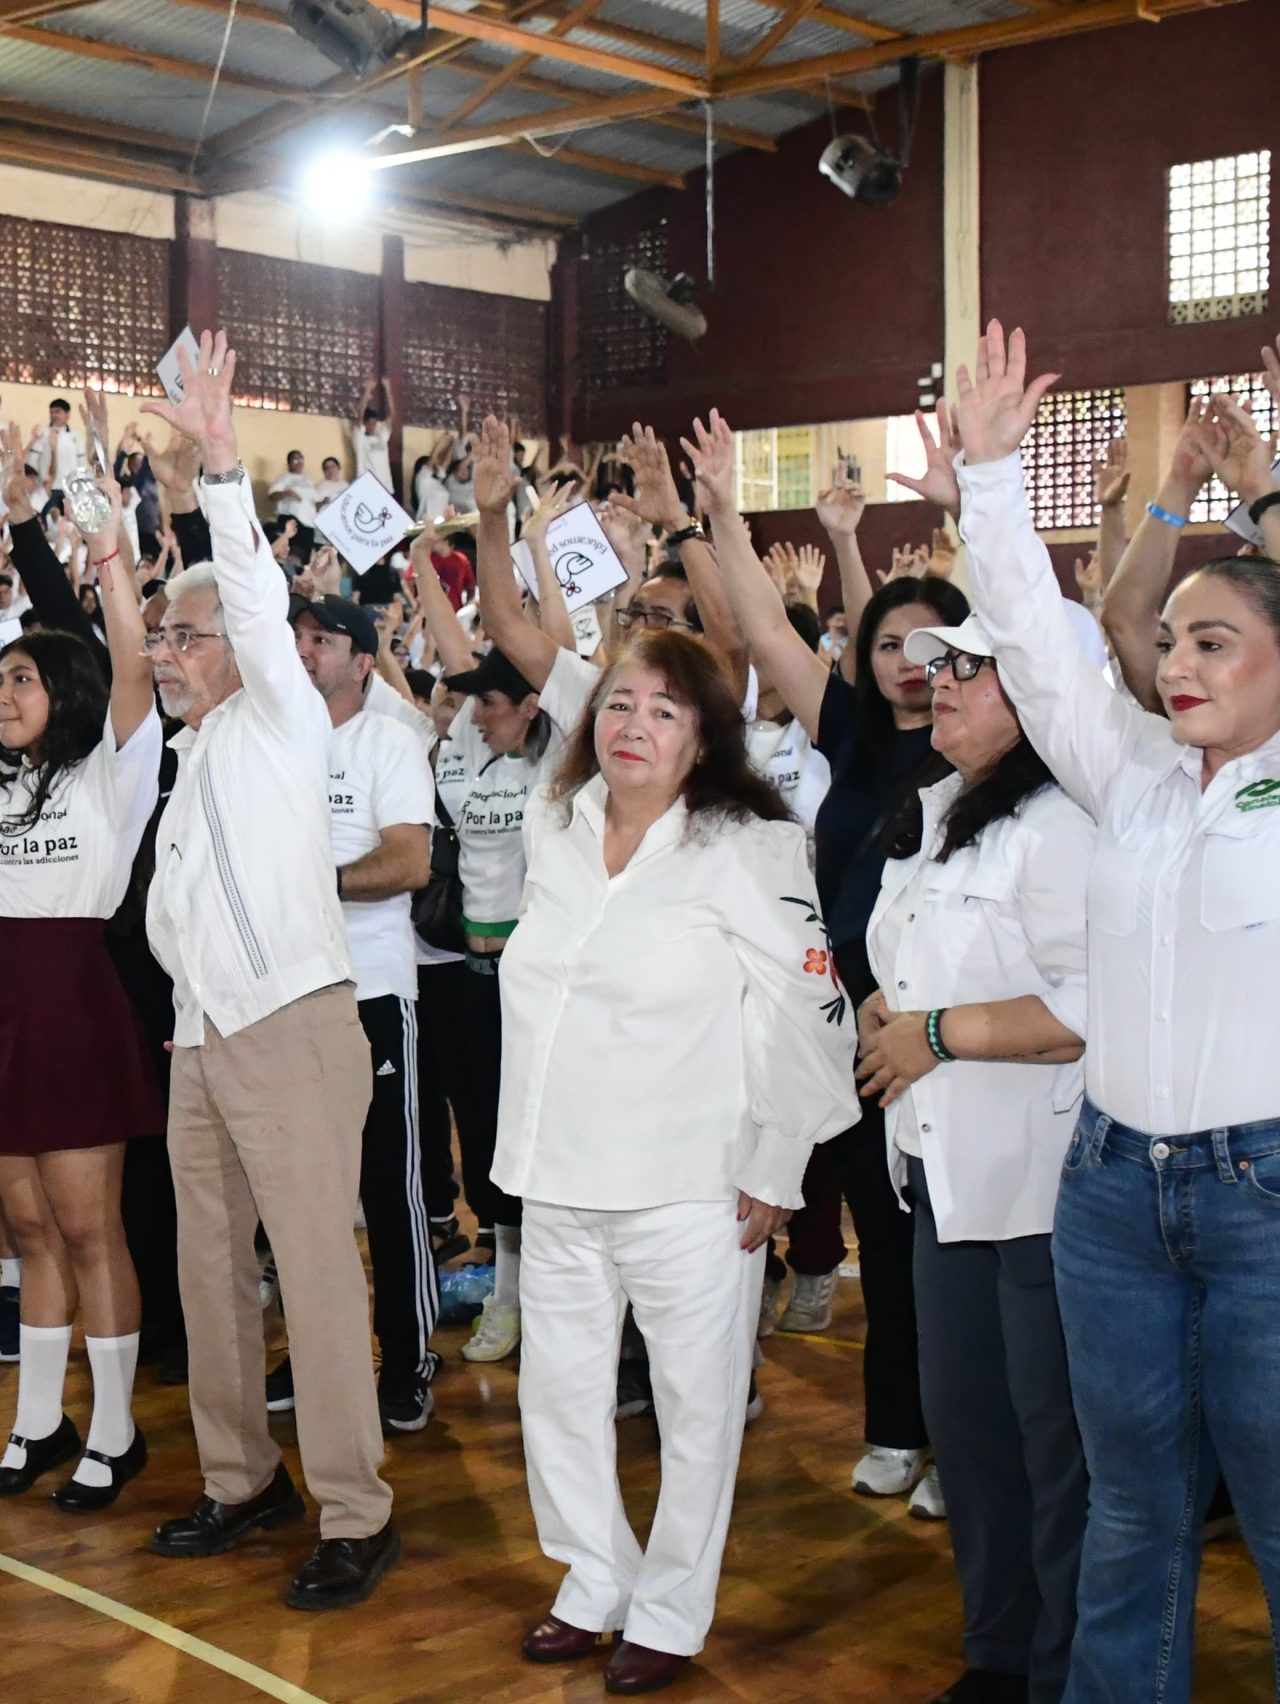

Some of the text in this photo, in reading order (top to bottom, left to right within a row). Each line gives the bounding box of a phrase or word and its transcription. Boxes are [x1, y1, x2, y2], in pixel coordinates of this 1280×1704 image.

[442, 768, 465, 780] paz
[778, 771, 800, 787] paz
[466, 810, 523, 826] Por la pa
[22, 838, 39, 854] la
[44, 837, 78, 856] paz
[23, 857, 34, 865] las
[35, 854, 79, 865] adicciones
